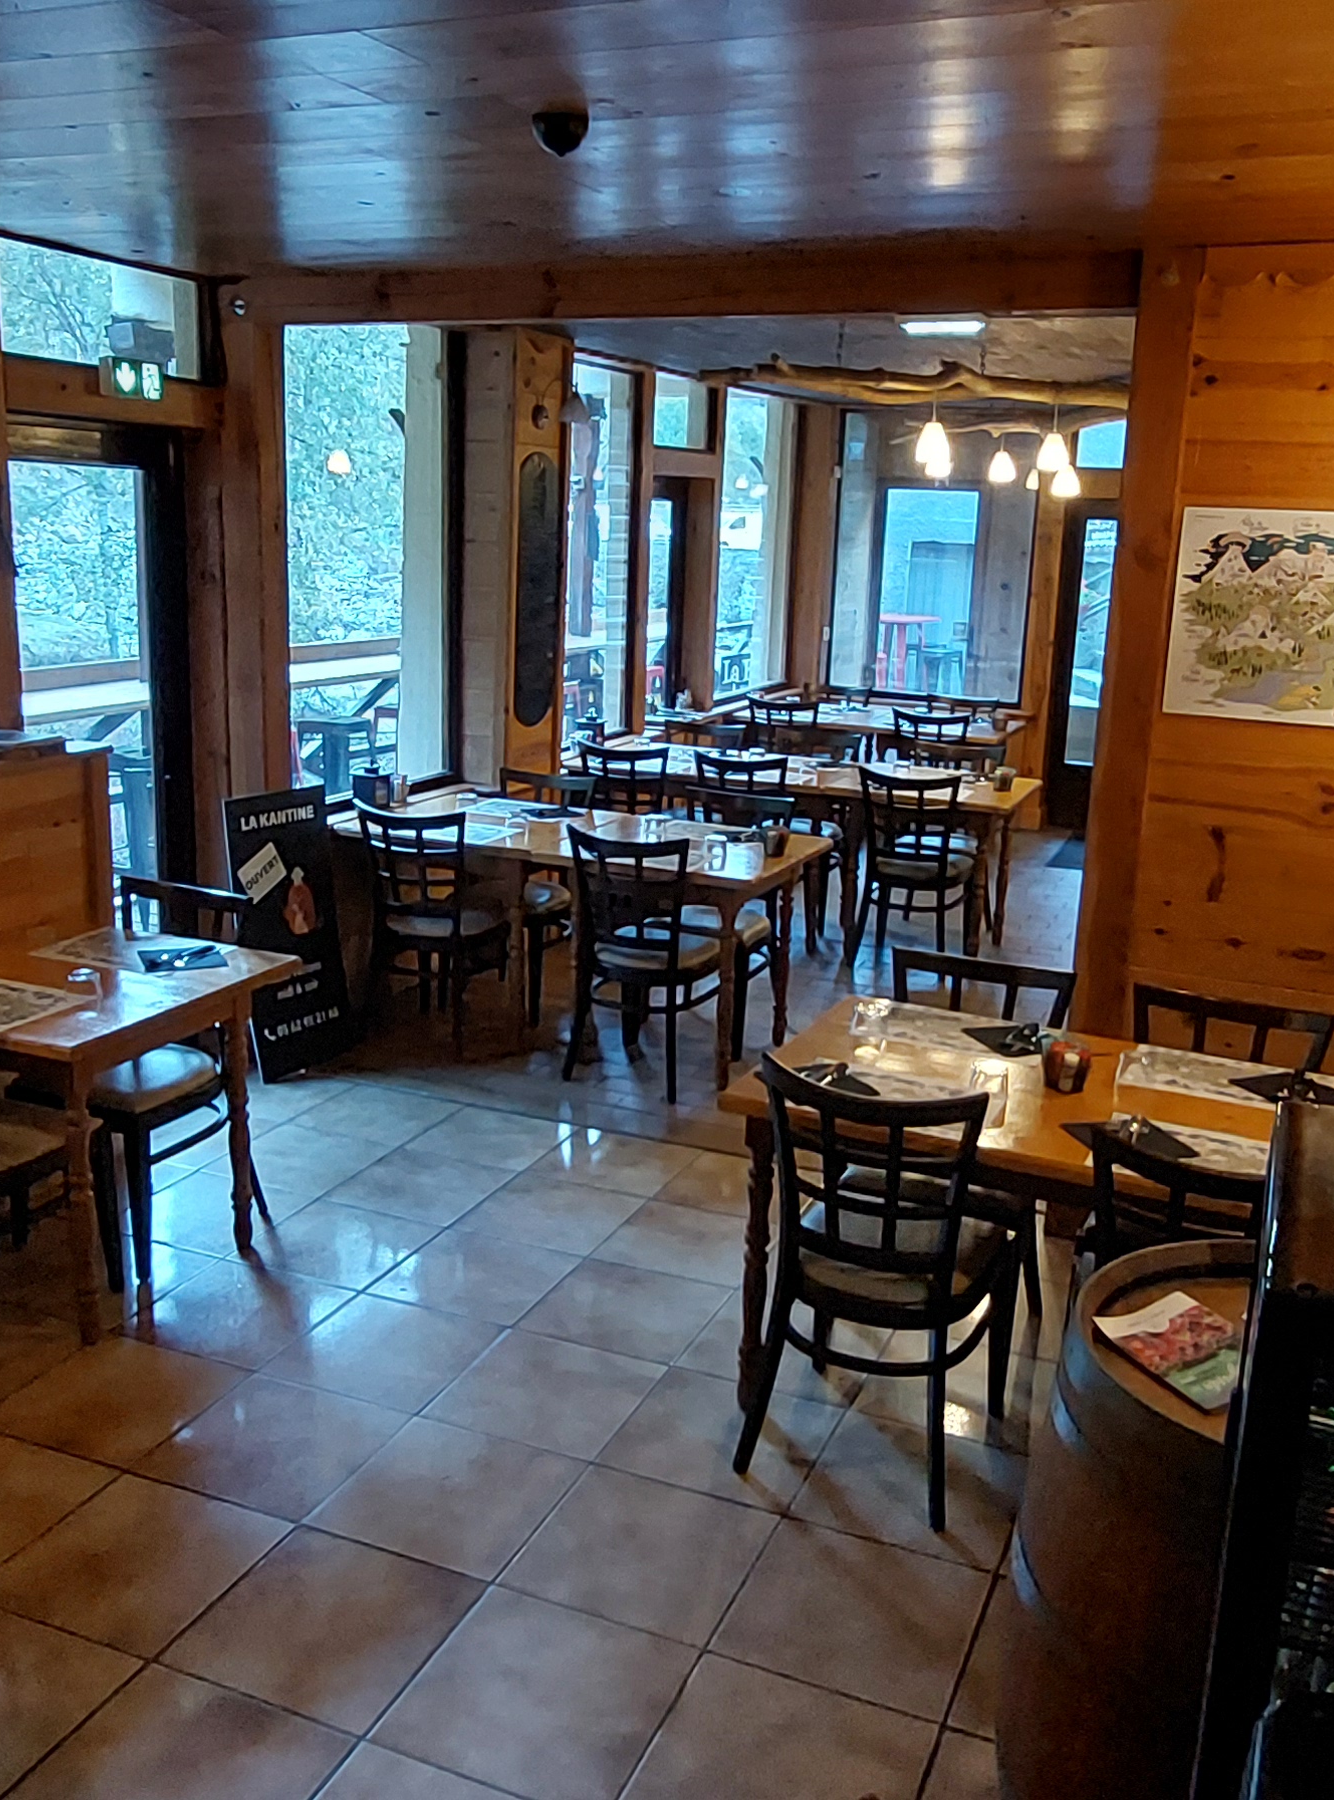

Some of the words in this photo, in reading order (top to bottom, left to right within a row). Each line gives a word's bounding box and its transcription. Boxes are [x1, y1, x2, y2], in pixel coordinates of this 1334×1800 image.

[240, 816, 258, 832] LA
[259, 805, 315, 828] KANTINE
[245, 855, 280, 891] OUVERT
